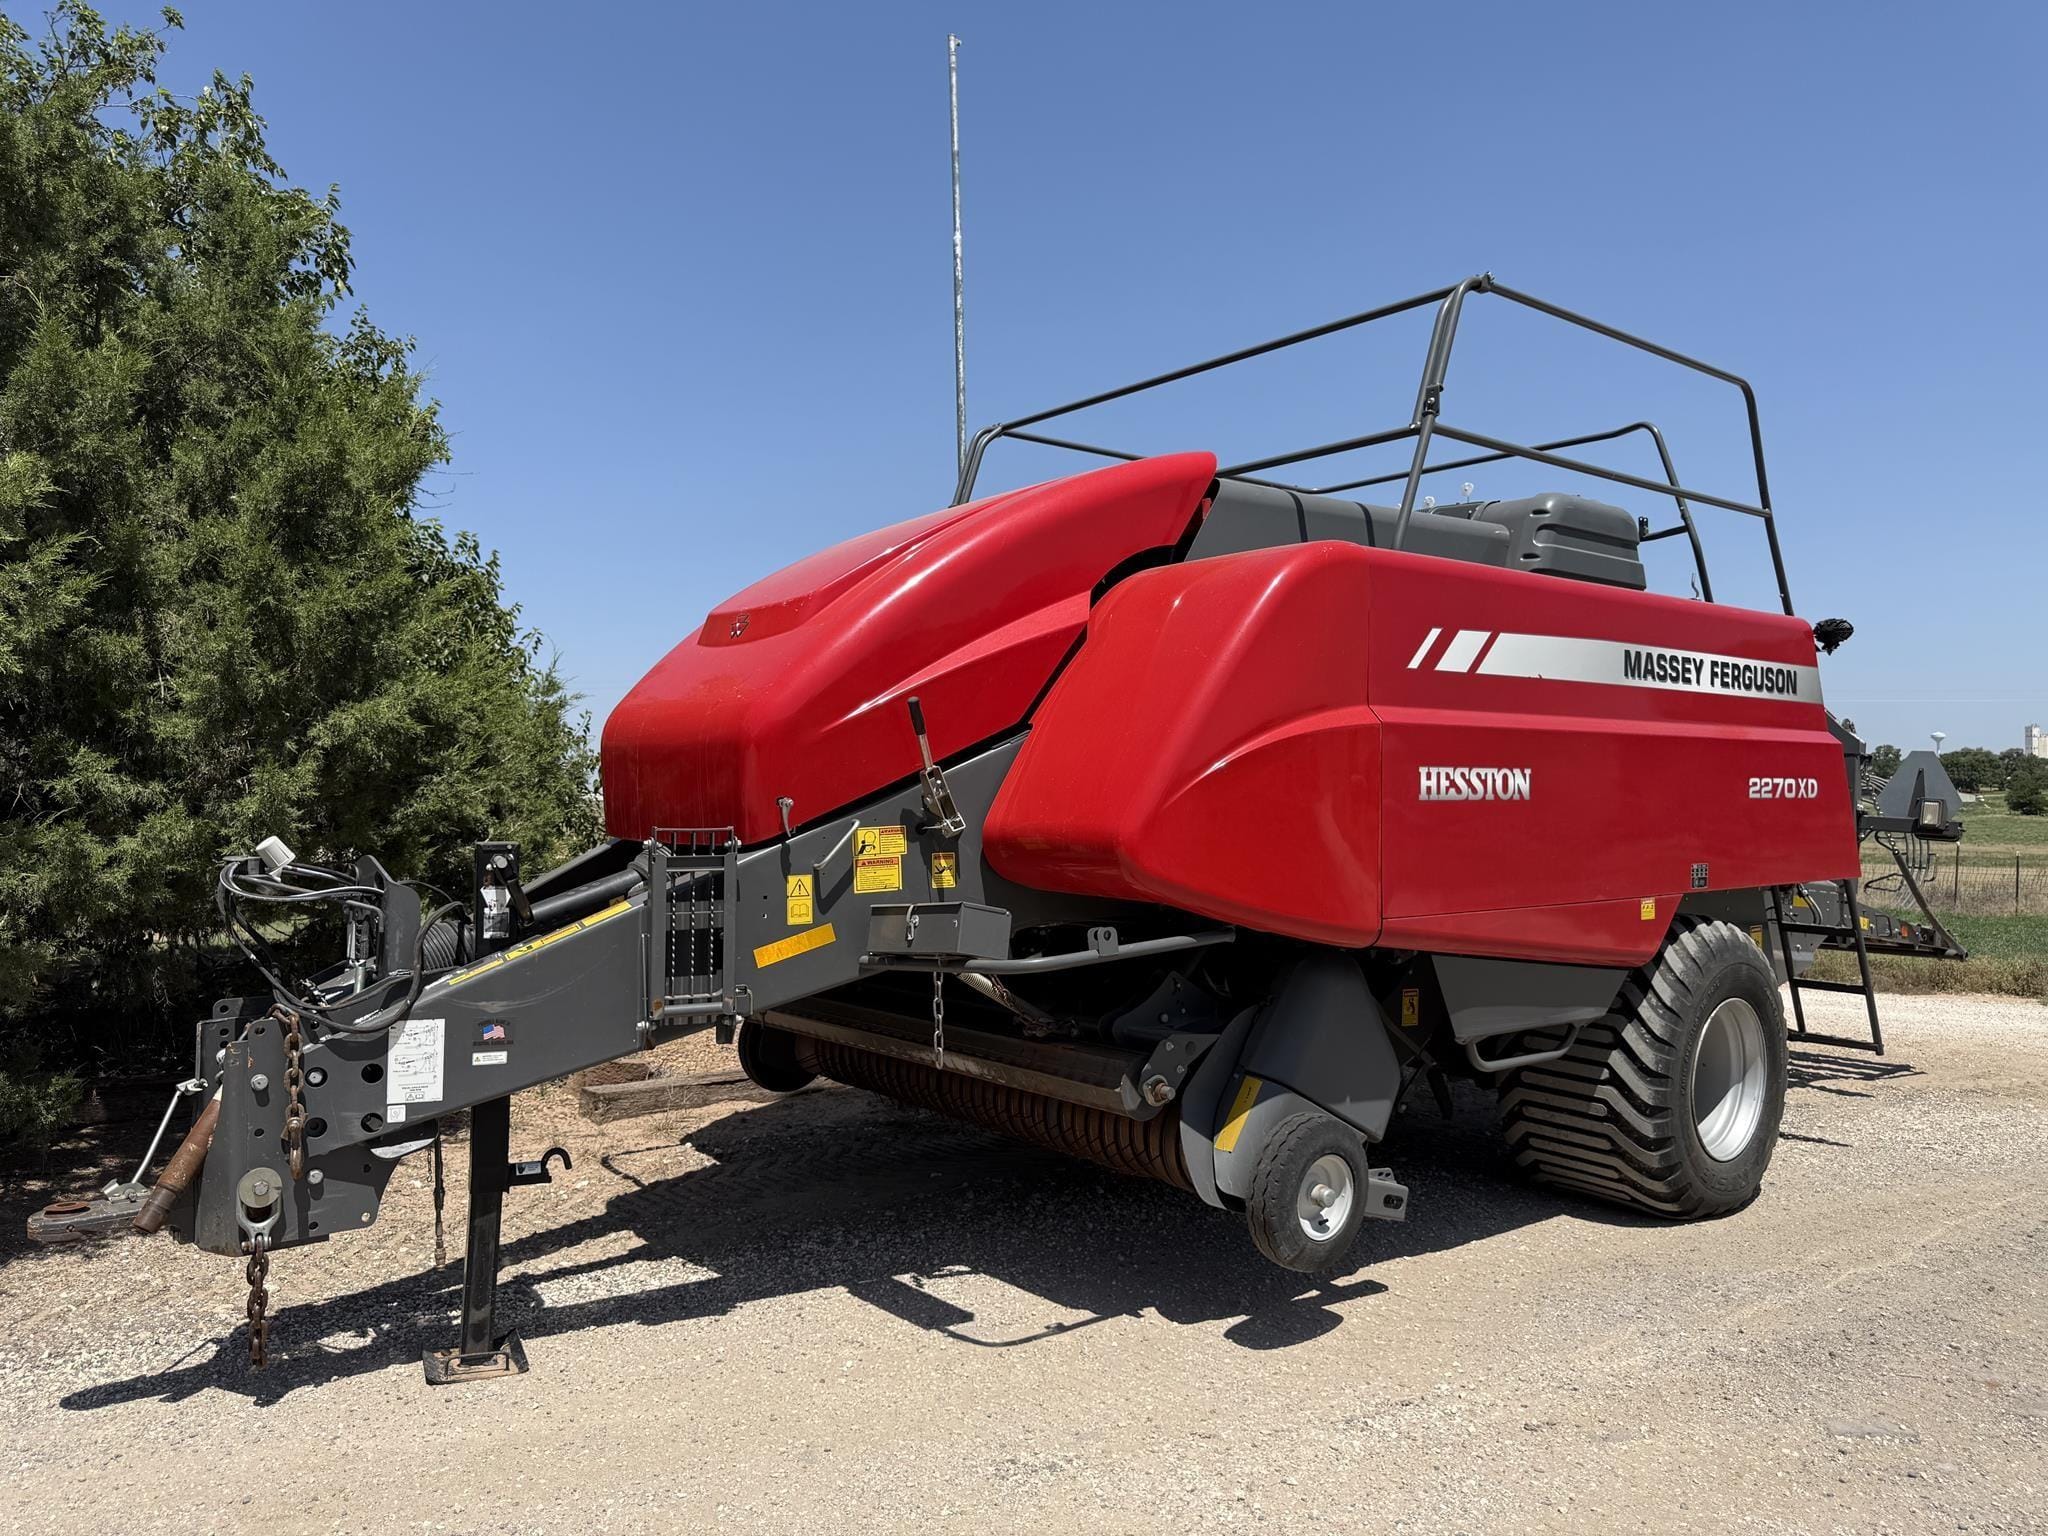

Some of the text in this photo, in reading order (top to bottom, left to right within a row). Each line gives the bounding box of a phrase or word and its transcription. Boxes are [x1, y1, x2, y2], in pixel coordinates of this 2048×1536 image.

[1624, 649, 1798, 696] MASSEY FERGUSON
[1419, 766, 1532, 801] HESSTON
[1749, 777, 1818, 799] 2270XD
